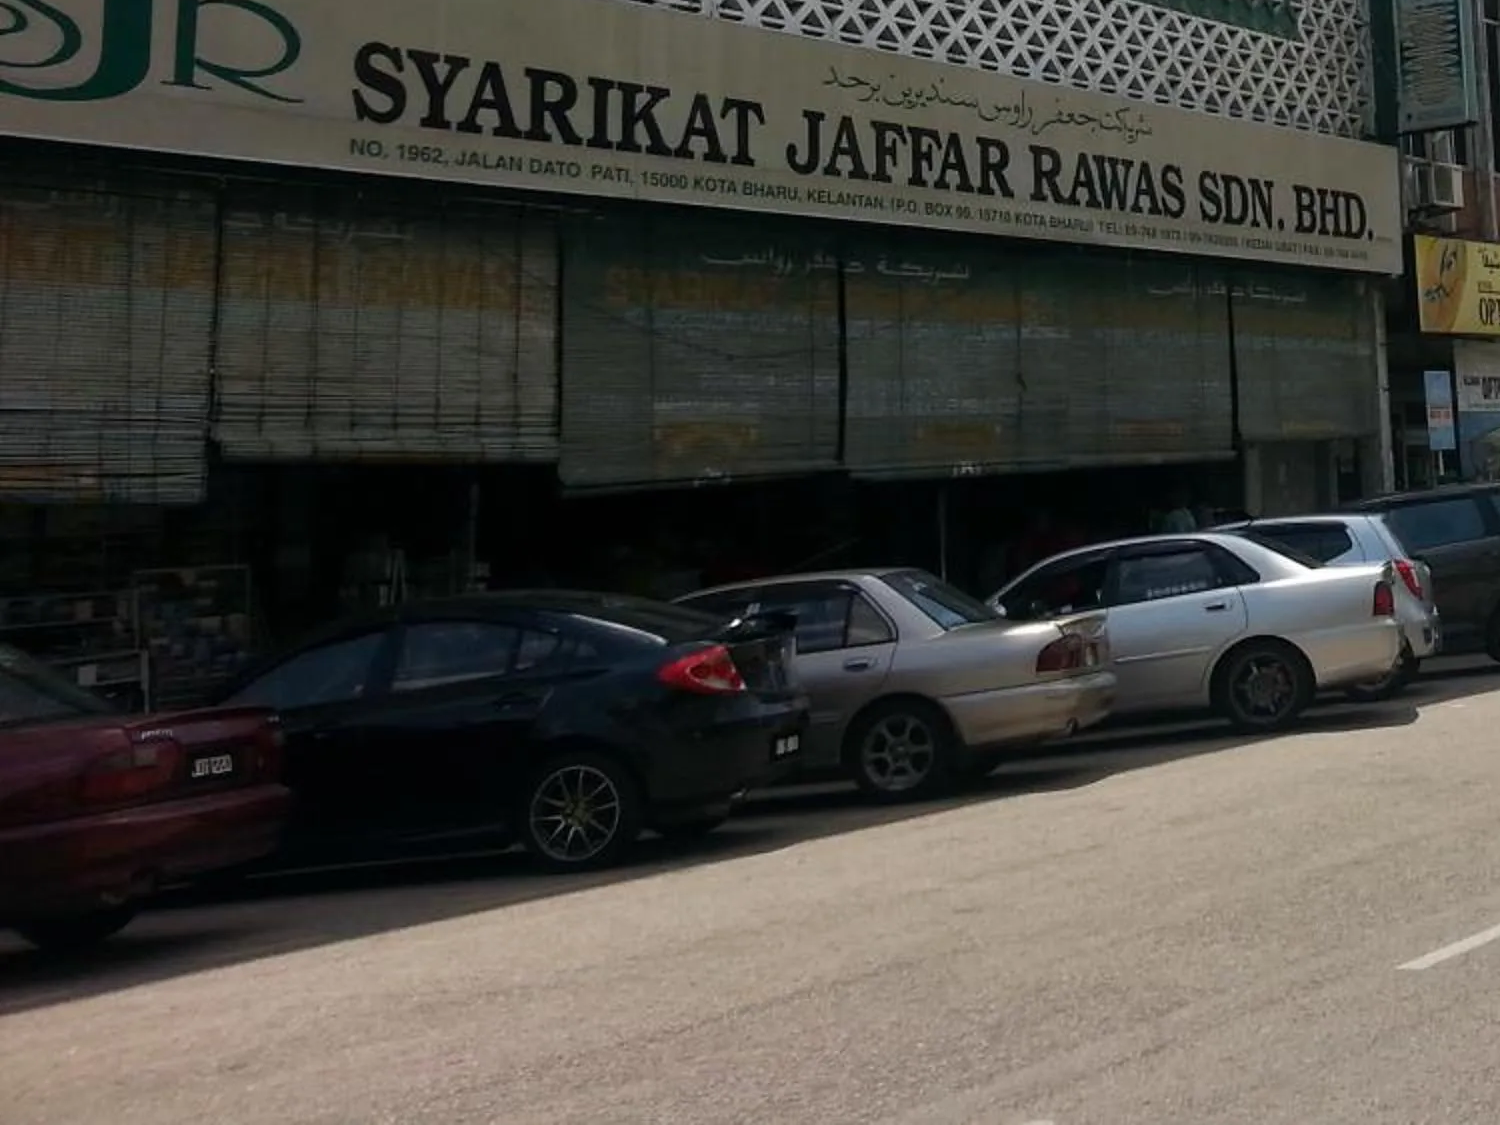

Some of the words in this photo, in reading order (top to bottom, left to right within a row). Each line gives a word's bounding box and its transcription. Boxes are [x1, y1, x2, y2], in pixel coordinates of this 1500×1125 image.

[351, 41, 765, 168] SYARIKAT
[786, 109, 1014, 200] JAFFAR
[1028, 144, 1186, 220] RAWAS
[1199, 171, 1286, 233] SDN.
[1294, 185, 1376, 242] BHD.
[454, 150, 522, 172] JALAN
[693, 178, 737, 196] KOTA
[925, 201, 953, 217] BOX
[1015, 212, 1048, 229] KOTA
